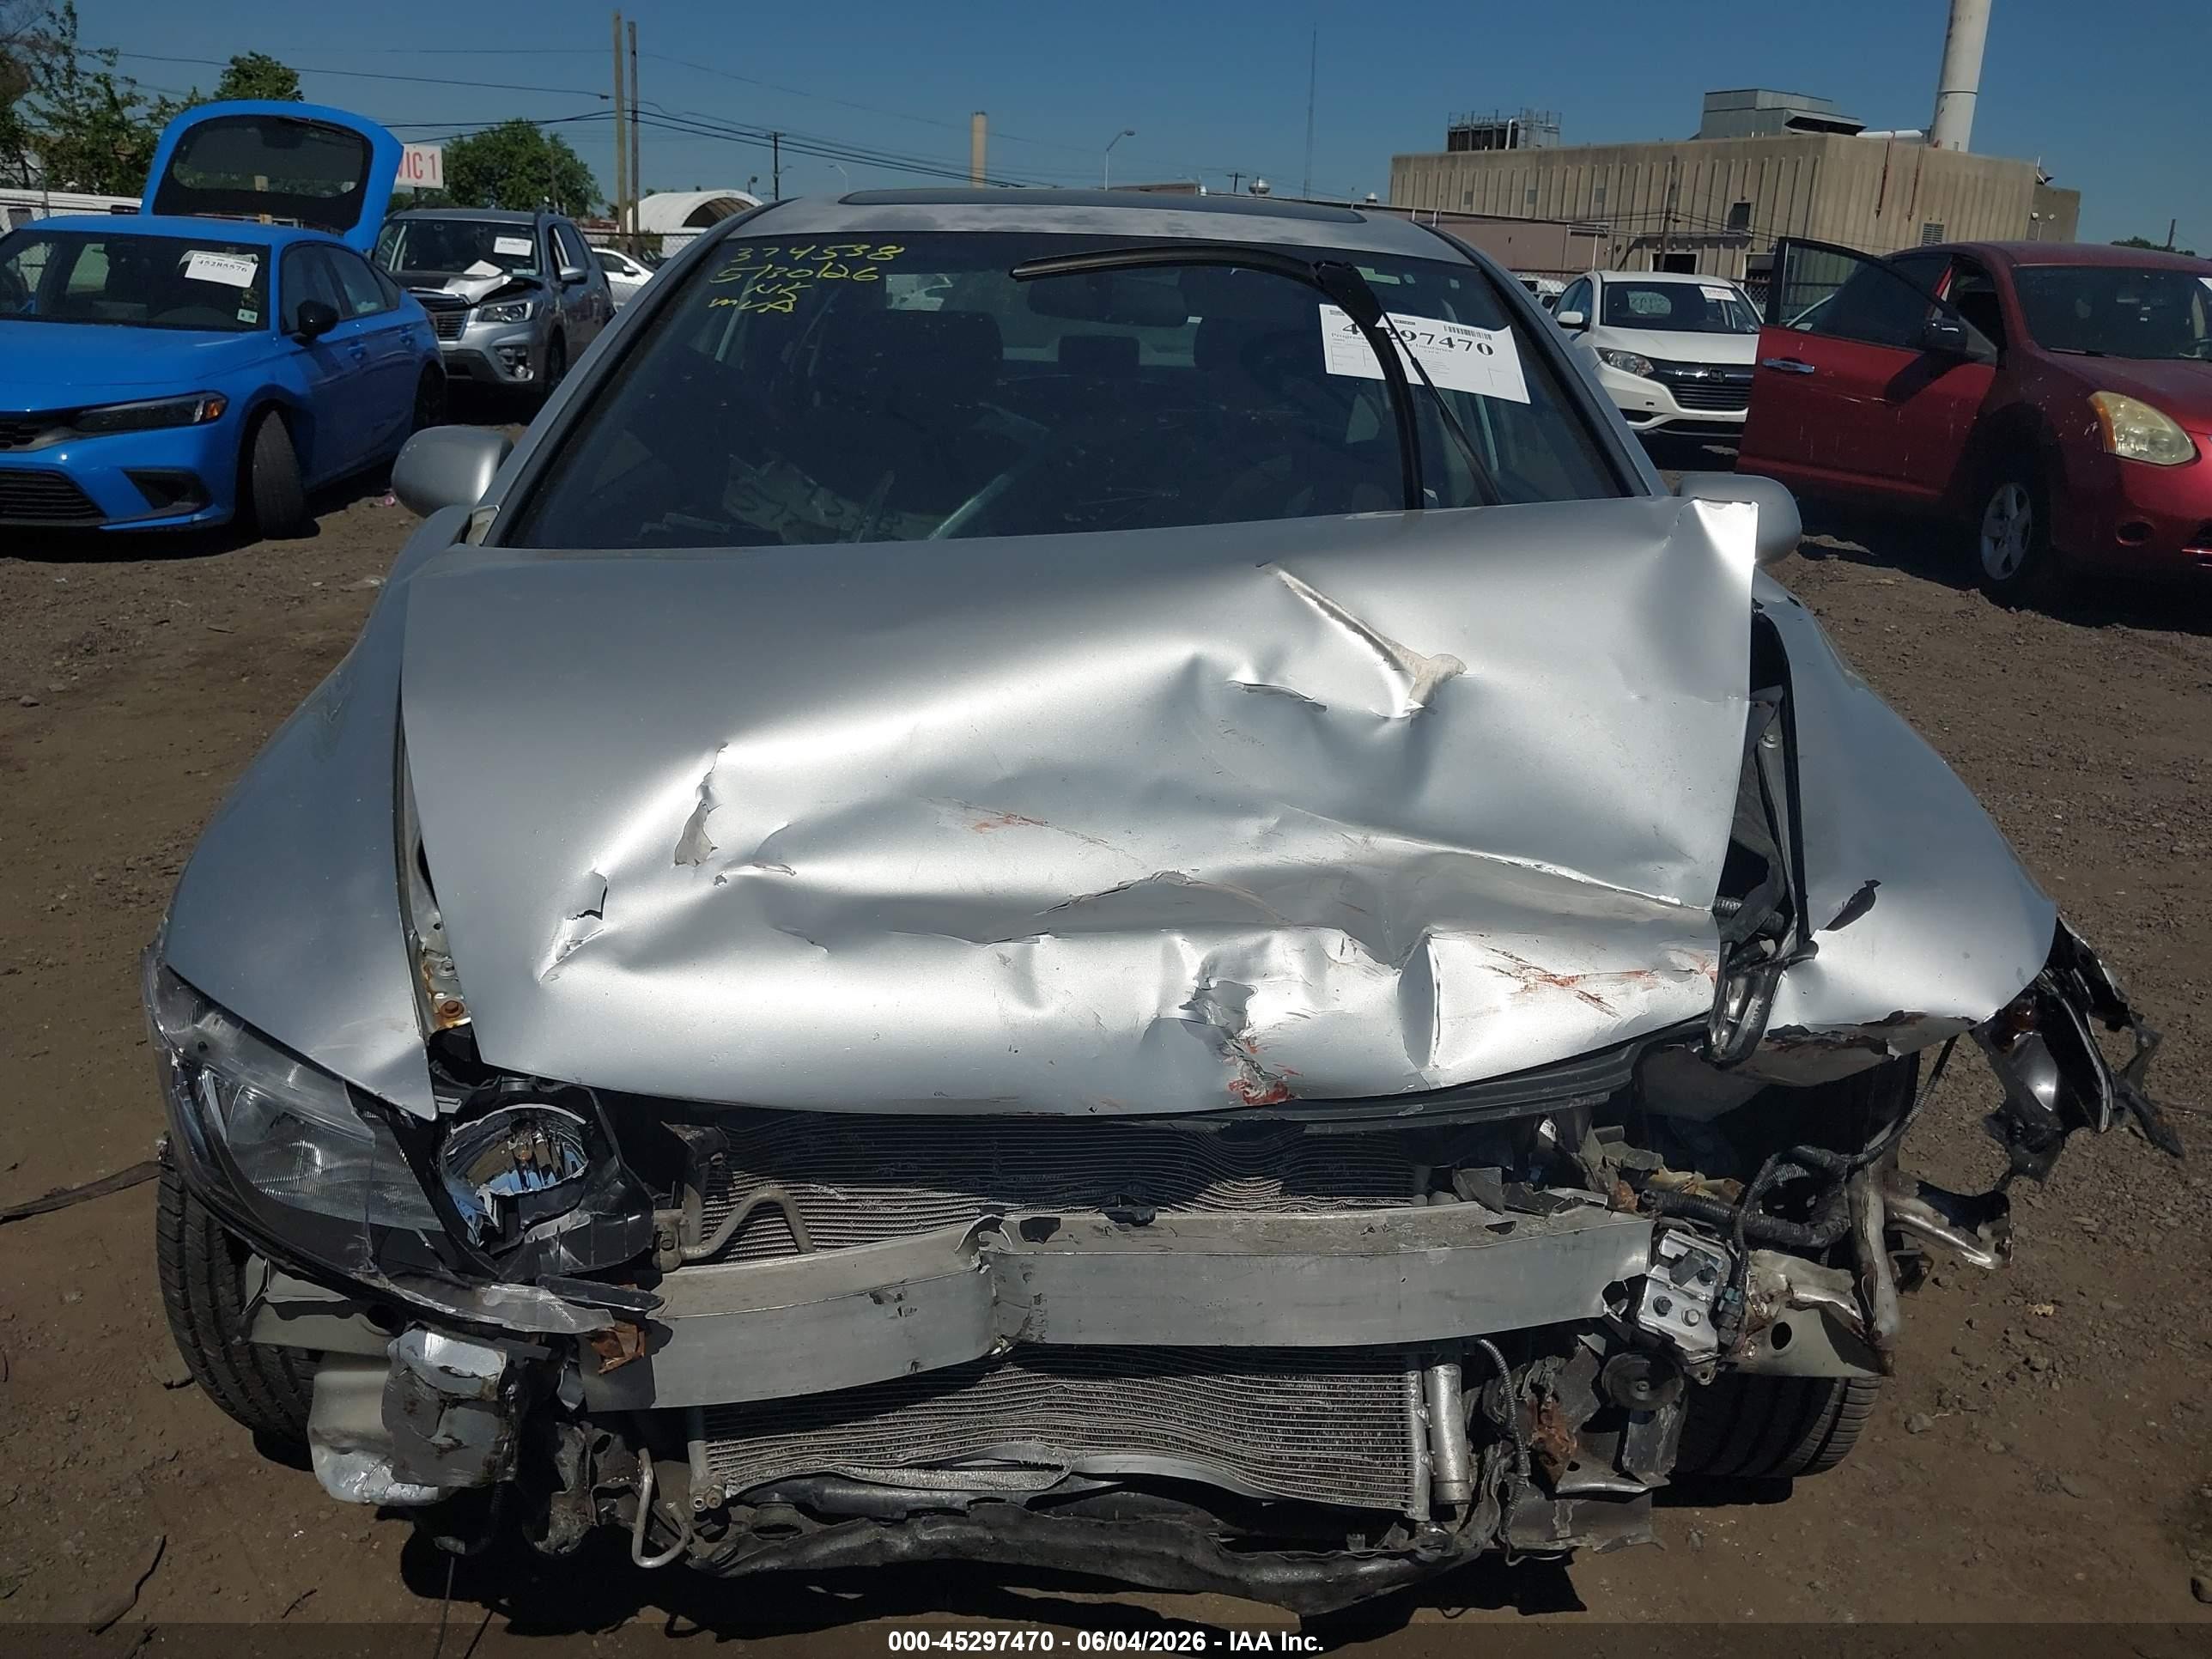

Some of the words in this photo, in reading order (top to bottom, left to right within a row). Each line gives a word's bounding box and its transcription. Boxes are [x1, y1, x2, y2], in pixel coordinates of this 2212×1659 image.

[429, 153, 436, 180] 1
[731, 245, 906, 263] 374538
[1342, 323, 1494, 356] 4297470
